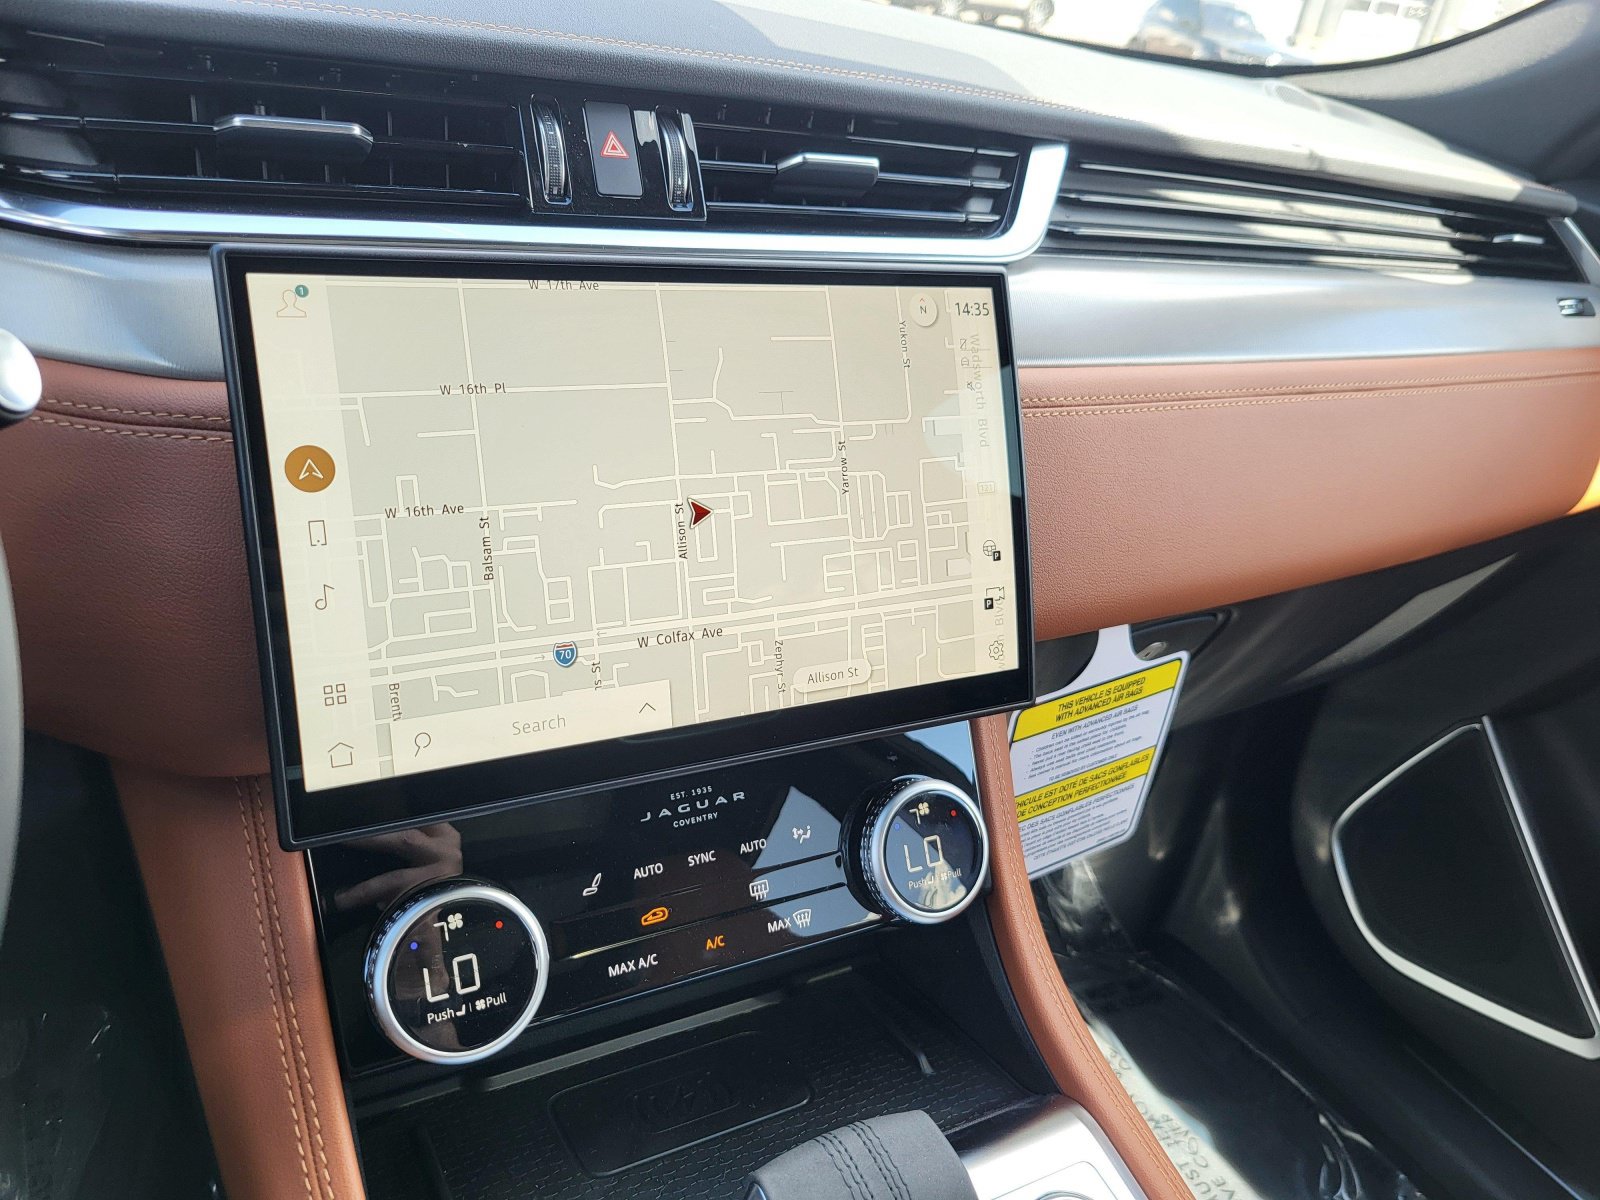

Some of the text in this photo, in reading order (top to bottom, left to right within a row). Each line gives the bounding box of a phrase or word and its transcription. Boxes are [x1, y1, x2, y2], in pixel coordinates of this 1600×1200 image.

[528, 280, 599, 290] W 17th Ave
[920, 306, 927, 314] N
[955, 302, 990, 316] 14:35
[899, 320, 910, 368] Yukon St
[439, 382, 507, 395] W 16th Pl
[978, 419, 990, 447] Blvd
[838, 440, 850, 495] Yarrow St
[385, 504, 465, 519] W 16th Ave
[675, 502, 689, 560] Allison St
[479, 516, 495, 580] Balsam St
[637, 626, 723, 648] W Colfax Ave
[560, 650, 572, 660] 70
[591, 661, 602, 673] St
[775, 639, 786, 694] Zephyr St
[807, 667, 859, 686] Allison St
[1055, 687, 1143, 722] WITH ADVANCED AIR BAGS
[1058, 677, 1146, 712] THIS VEHICLE IS EQUIPPED
[512, 714, 567, 736] Search
[1051, 728, 1068, 740] EVEN
[1016, 793, 1043, 809] HICULE
[1044, 788, 1057, 798] EST
[1079, 777, 1089, 786] DE
[1090, 770, 1107, 780] SACS
[1108, 753, 1150, 776] GONFLABLES
[670, 785, 713, 801] EST. 1935
[640, 791, 746, 822] JAGUAR
[1017, 809, 1027, 818] DE
[1028, 792, 1073, 813] CONCEPTION
[673, 811, 719, 828] COVENTRY
[740, 838, 767, 855] AUTO
[903, 834, 943, 873] LO
[687, 850, 717, 867] SYNC
[633, 862, 664, 880] AUTO
[908, 868, 962, 890] Push Pull
[767, 917, 792, 933] MAX
[705, 935, 726, 950] A/C
[608, 953, 659, 978] MAX A/C
[423, 953, 481, 1003] LO
[426, 992, 507, 1024] Push Pull
